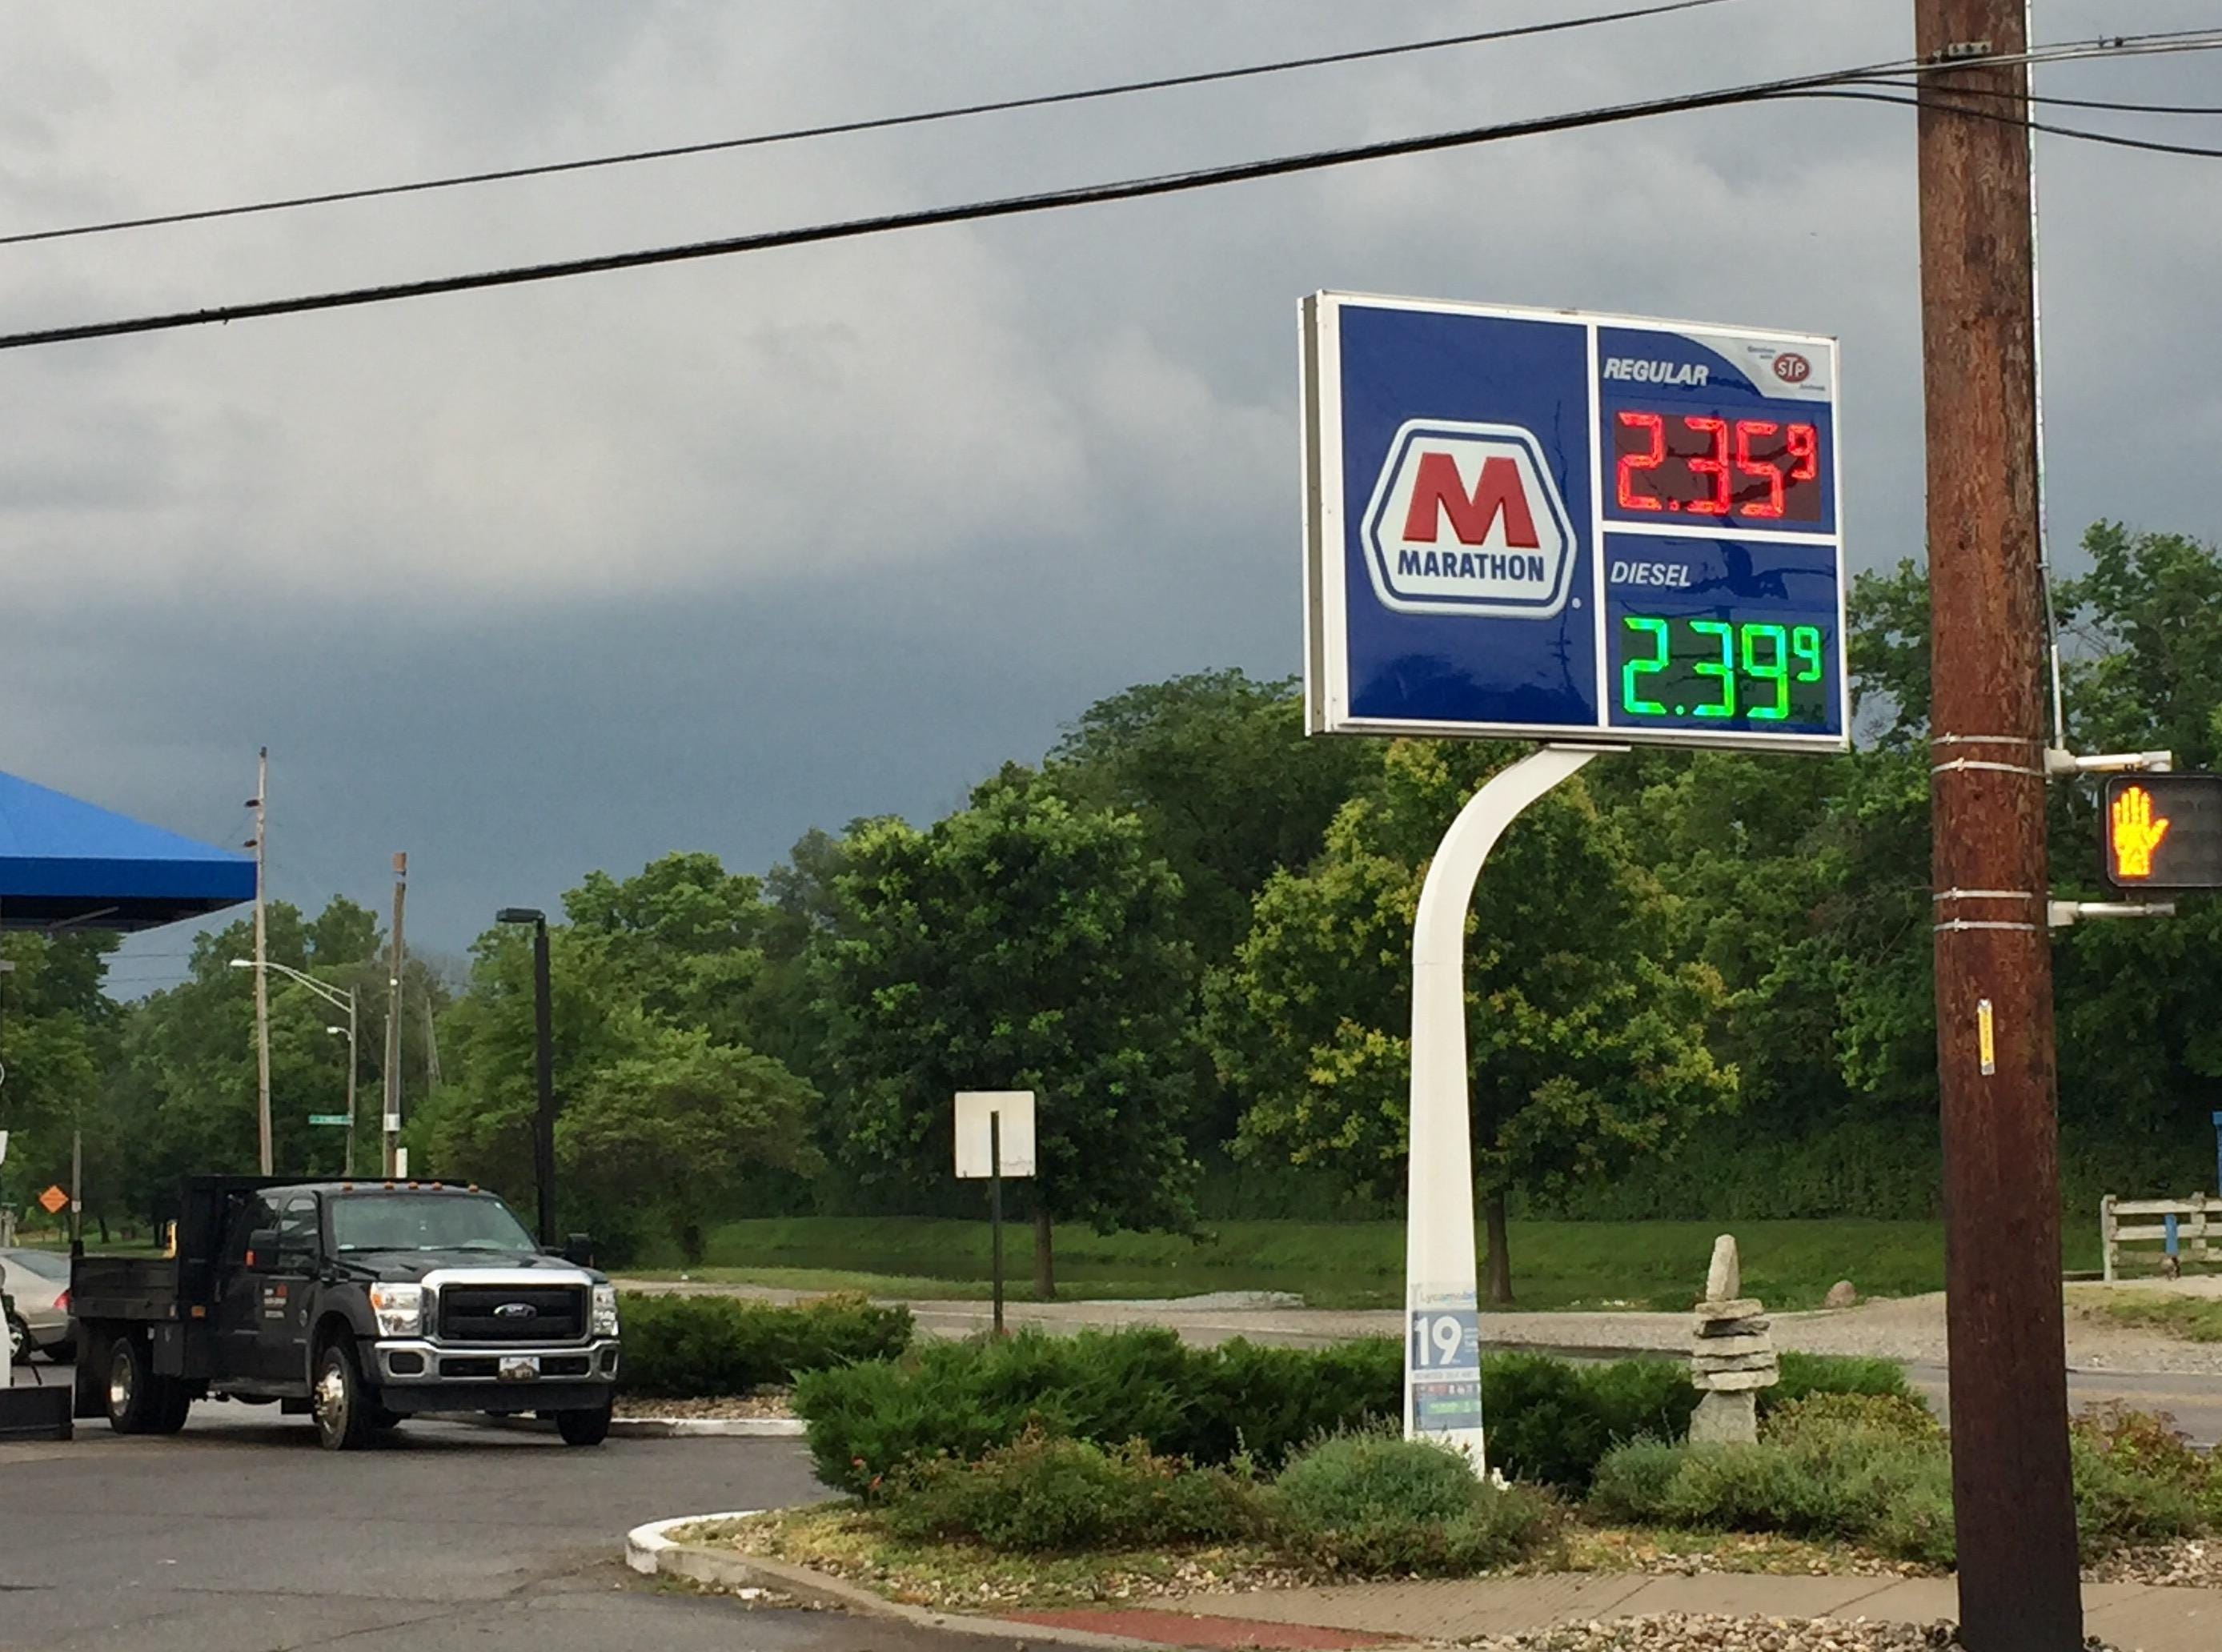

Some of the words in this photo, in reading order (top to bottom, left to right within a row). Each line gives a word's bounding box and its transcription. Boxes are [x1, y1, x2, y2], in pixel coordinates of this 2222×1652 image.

[1603, 358, 1710, 386] REGULAR
[1778, 356, 1806, 379] STP
[1402, 451, 1540, 549] M
[1398, 550, 1545, 582] MARATHON
[1610, 561, 1691, 587] DIESEL
[1414, 1316, 1462, 1365] 19
